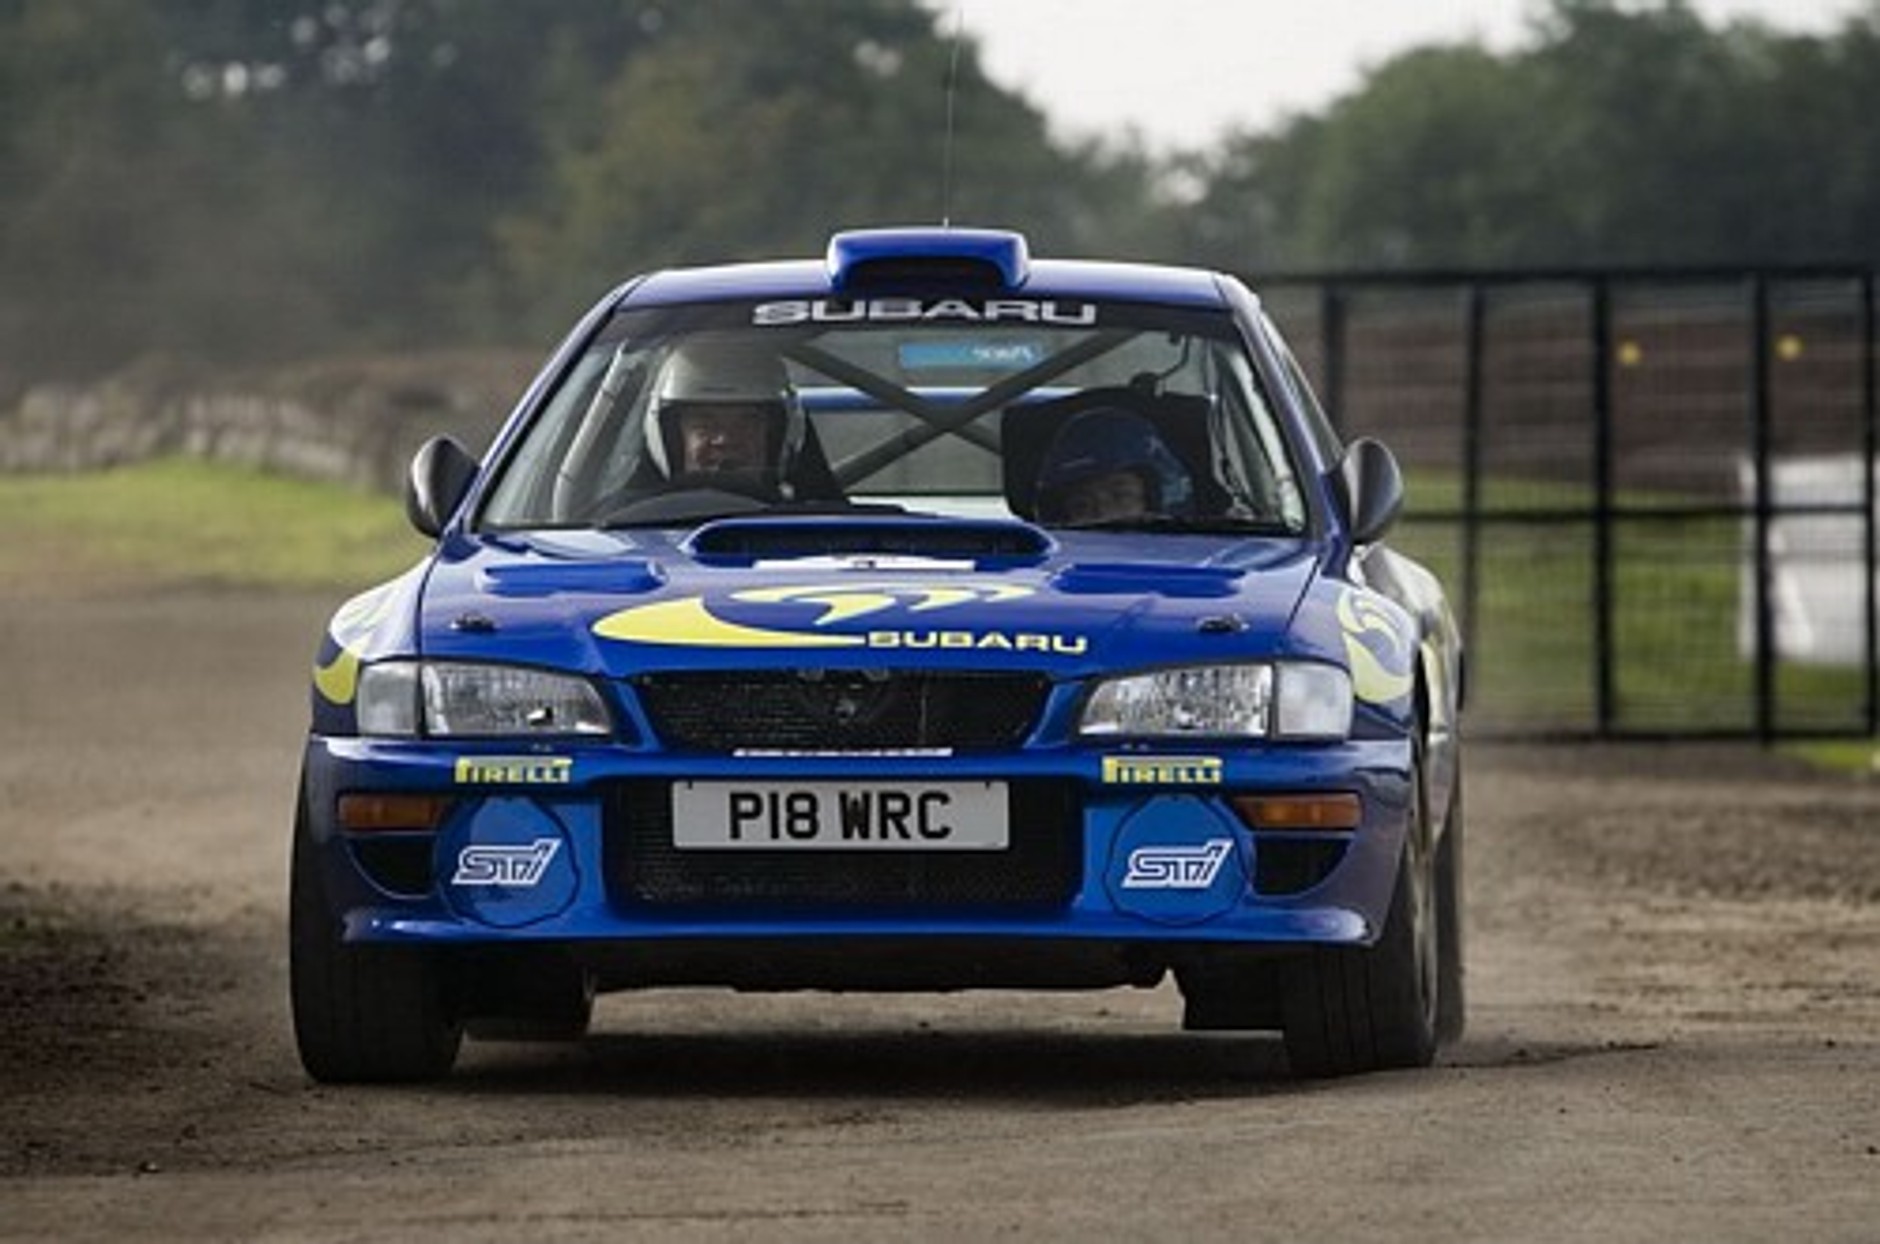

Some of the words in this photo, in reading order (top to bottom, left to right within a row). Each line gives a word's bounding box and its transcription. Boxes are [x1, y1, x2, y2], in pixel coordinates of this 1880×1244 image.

[753, 300, 1096, 325] SUBARU
[868, 631, 1088, 654] SUBARU
[454, 756, 573, 783] PIRELLI
[1102, 756, 1223, 783] PIRELLI
[729, 791, 820, 840] P18
[838, 791, 952, 840] WRC
